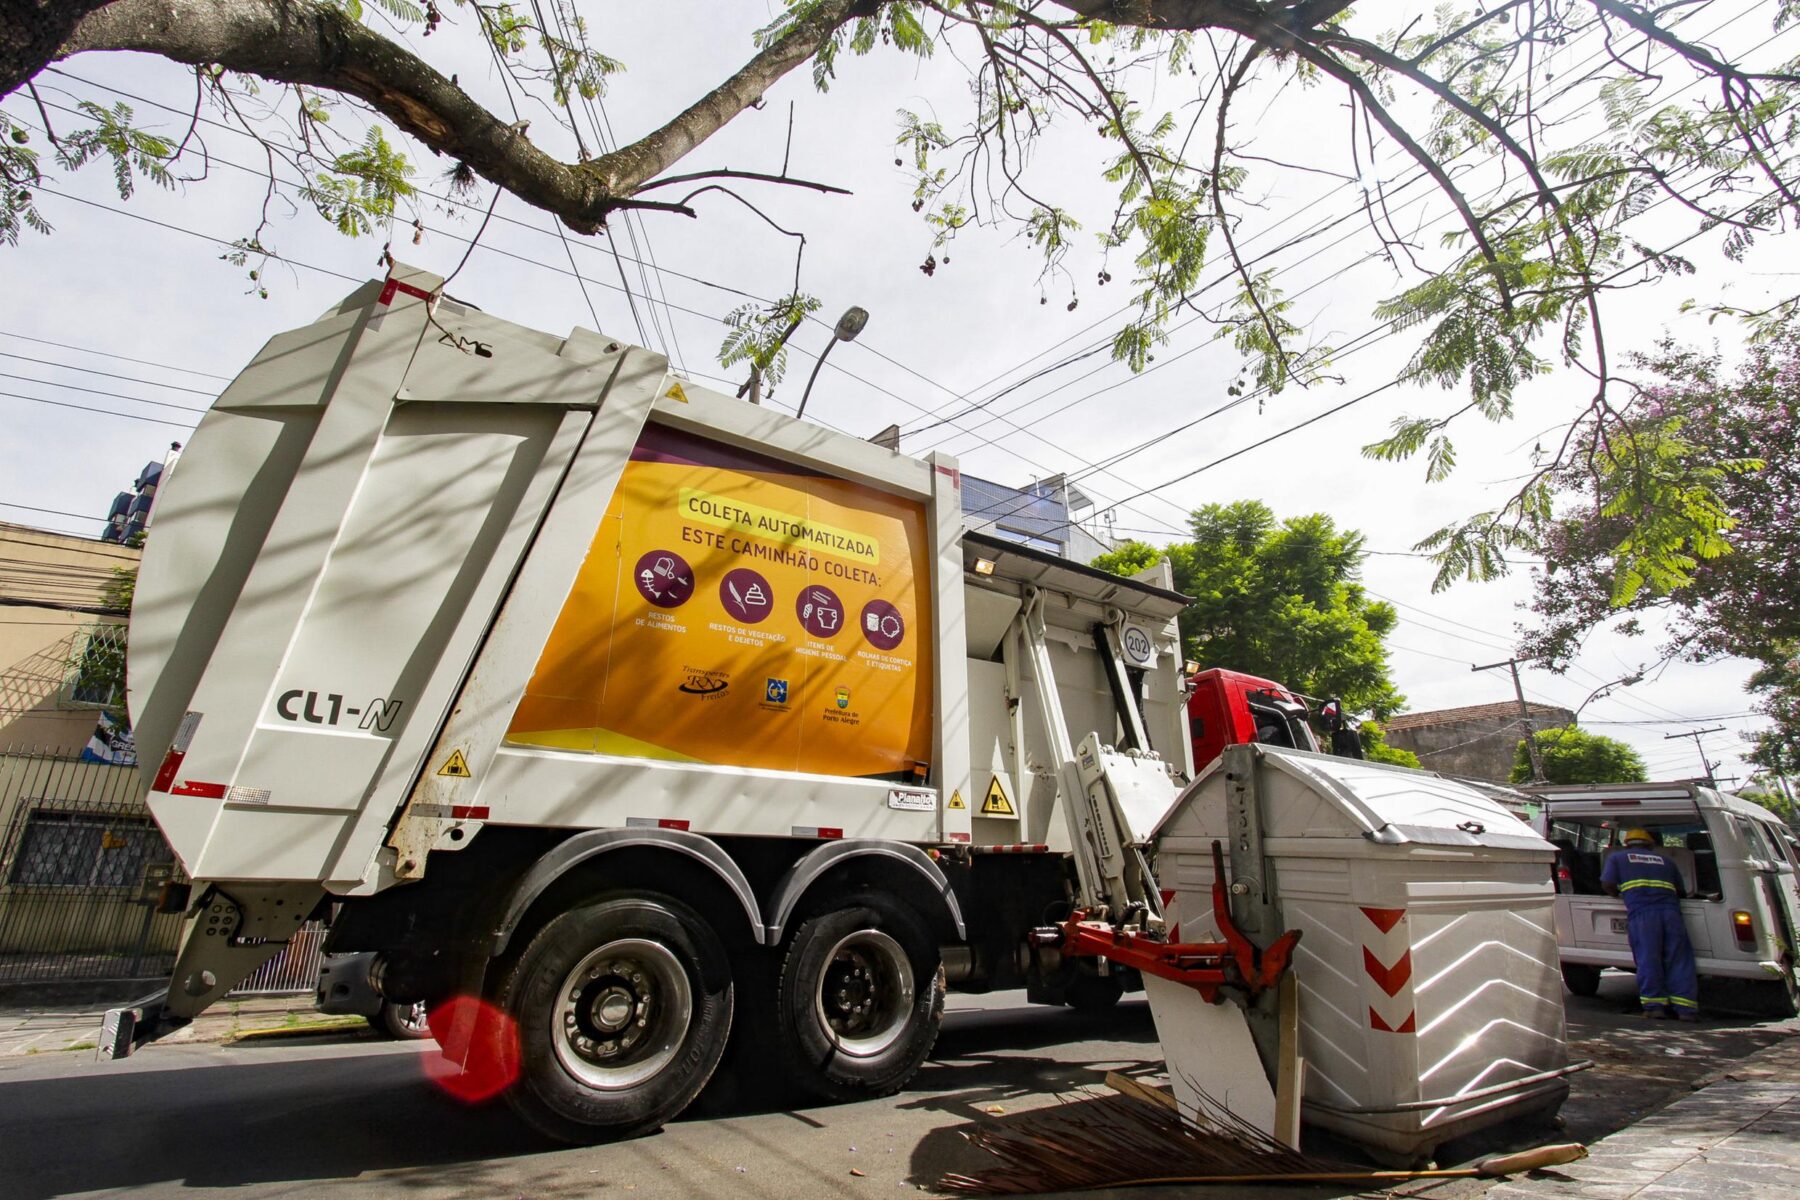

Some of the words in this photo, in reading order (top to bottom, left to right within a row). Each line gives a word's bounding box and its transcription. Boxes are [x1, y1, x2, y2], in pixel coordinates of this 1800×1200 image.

[689, 497, 752, 526] COLETA
[758, 516, 875, 557] AUTOMATIZADA
[682, 526, 725, 550] ESTE
[731, 538, 819, 571] CAMINHÃO
[824, 561, 882, 588] COLETA:
[648, 611, 675, 622] RESTOS
[635, 618, 645, 626] DE
[647, 621, 687, 633] ALIMENTOS
[709, 622, 737, 634] RESTOS
[737, 627, 747, 636] DE
[748, 629, 786, 643] VEGETAÇÃO
[728, 634, 733, 642] E
[734, 636, 764, 647] DEJETOS
[807, 641, 825, 650] ITENS
[1128, 635, 1147, 655] 202
[795, 647, 820, 657] HIGIENE
[821, 651, 847, 662] PESSOAL
[871, 661, 902, 672] ETIQUETAS
[277, 689, 403, 732] CL1-N
[825, 707, 851, 717] Prefeitura
[823, 714, 839, 723] Porto
[840, 716, 860, 726] Alegre
